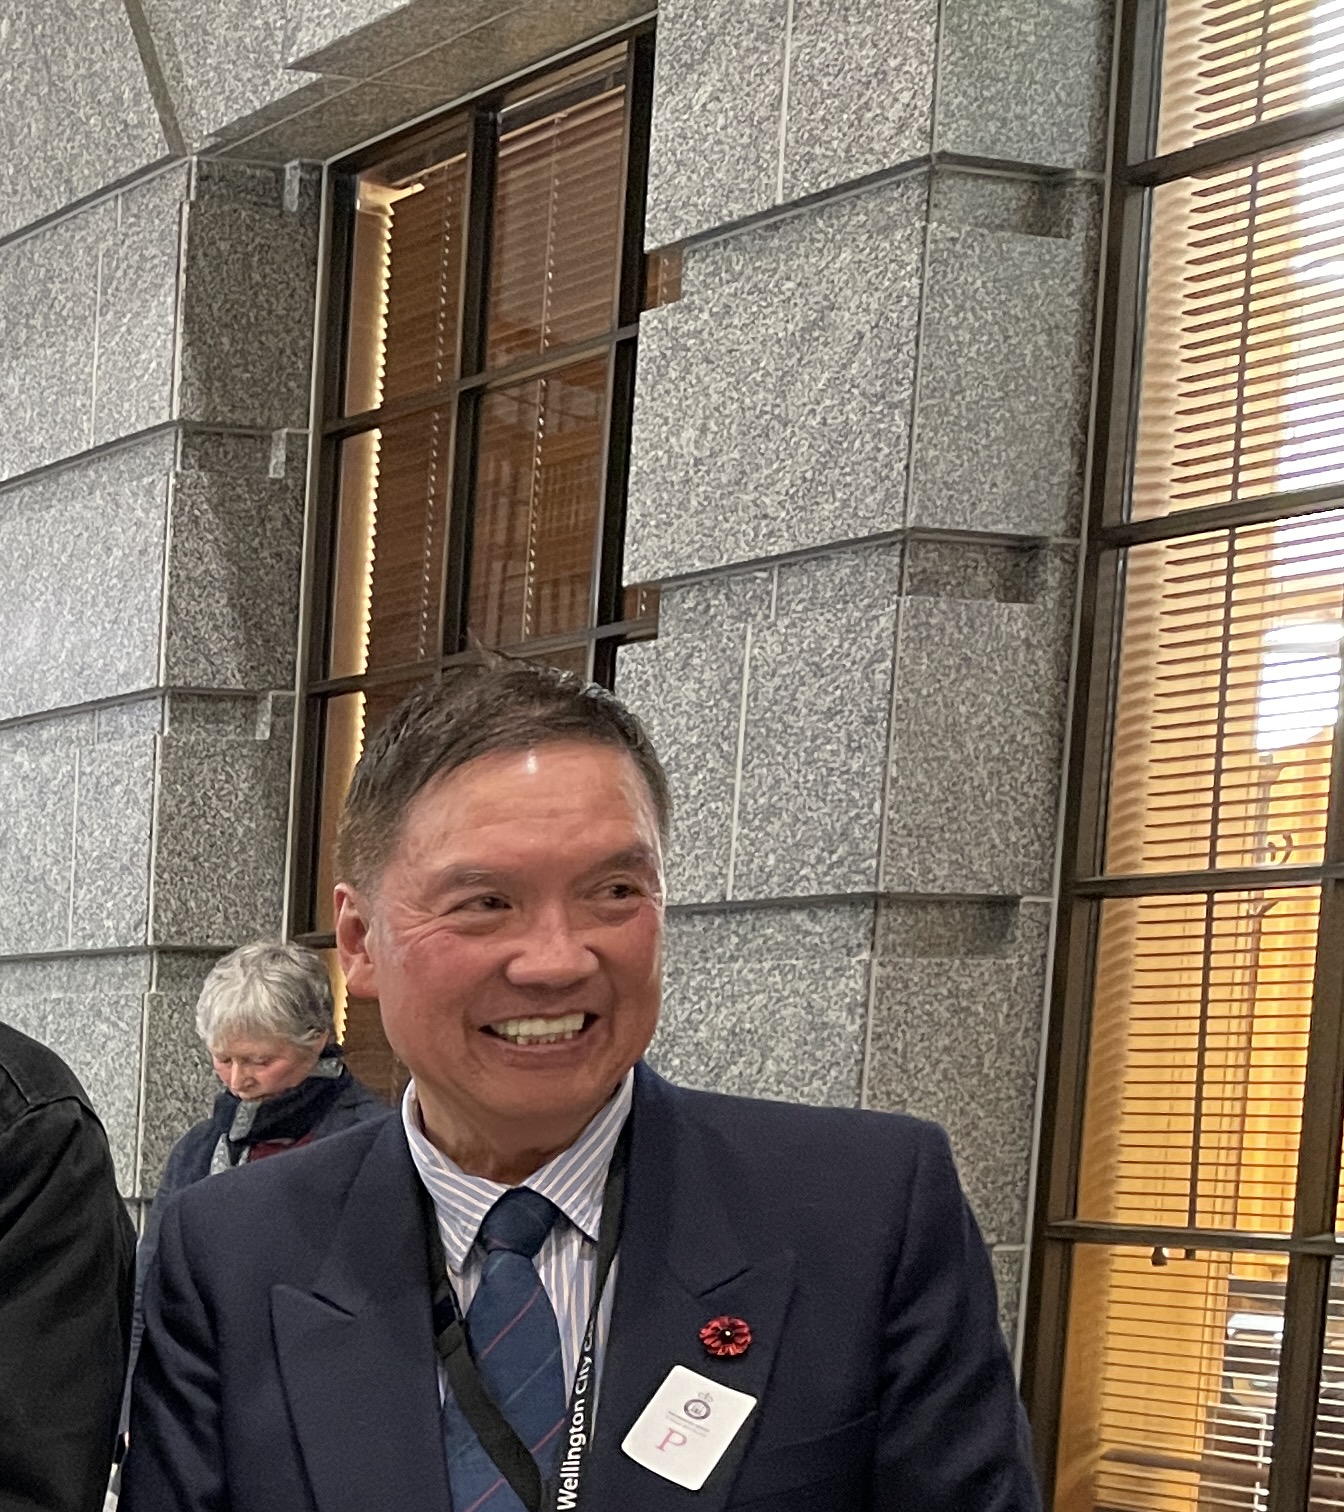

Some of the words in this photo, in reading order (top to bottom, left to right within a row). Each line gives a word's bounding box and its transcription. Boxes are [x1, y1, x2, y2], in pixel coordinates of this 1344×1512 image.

[556, 1398, 587, 1511] Wellington
[575, 1355, 593, 1395] City
[654, 1427, 688, 1452] P
